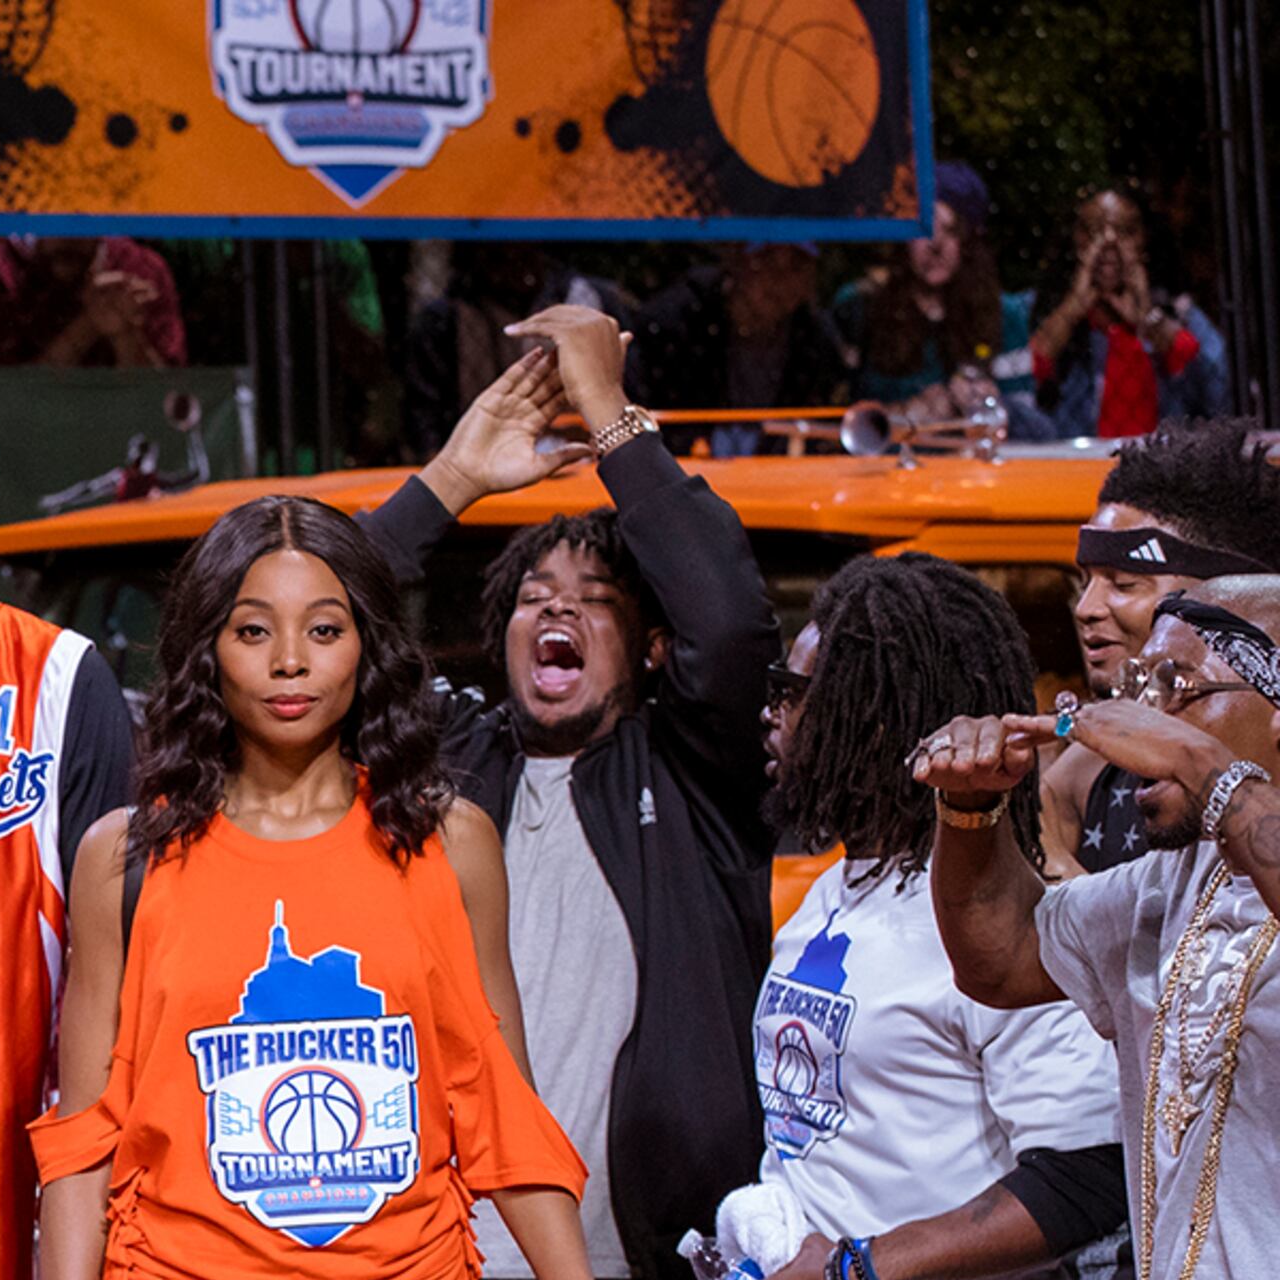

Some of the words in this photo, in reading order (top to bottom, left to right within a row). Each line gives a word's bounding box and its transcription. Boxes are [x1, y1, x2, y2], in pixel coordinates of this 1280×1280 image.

[230, 47, 474, 100] TOURNAMENT
[195, 1031, 250, 1086] THE
[256, 1024, 378, 1069] RUCKER
[383, 1021, 416, 1077] 50
[219, 1143, 411, 1185] TOURNAMENT
